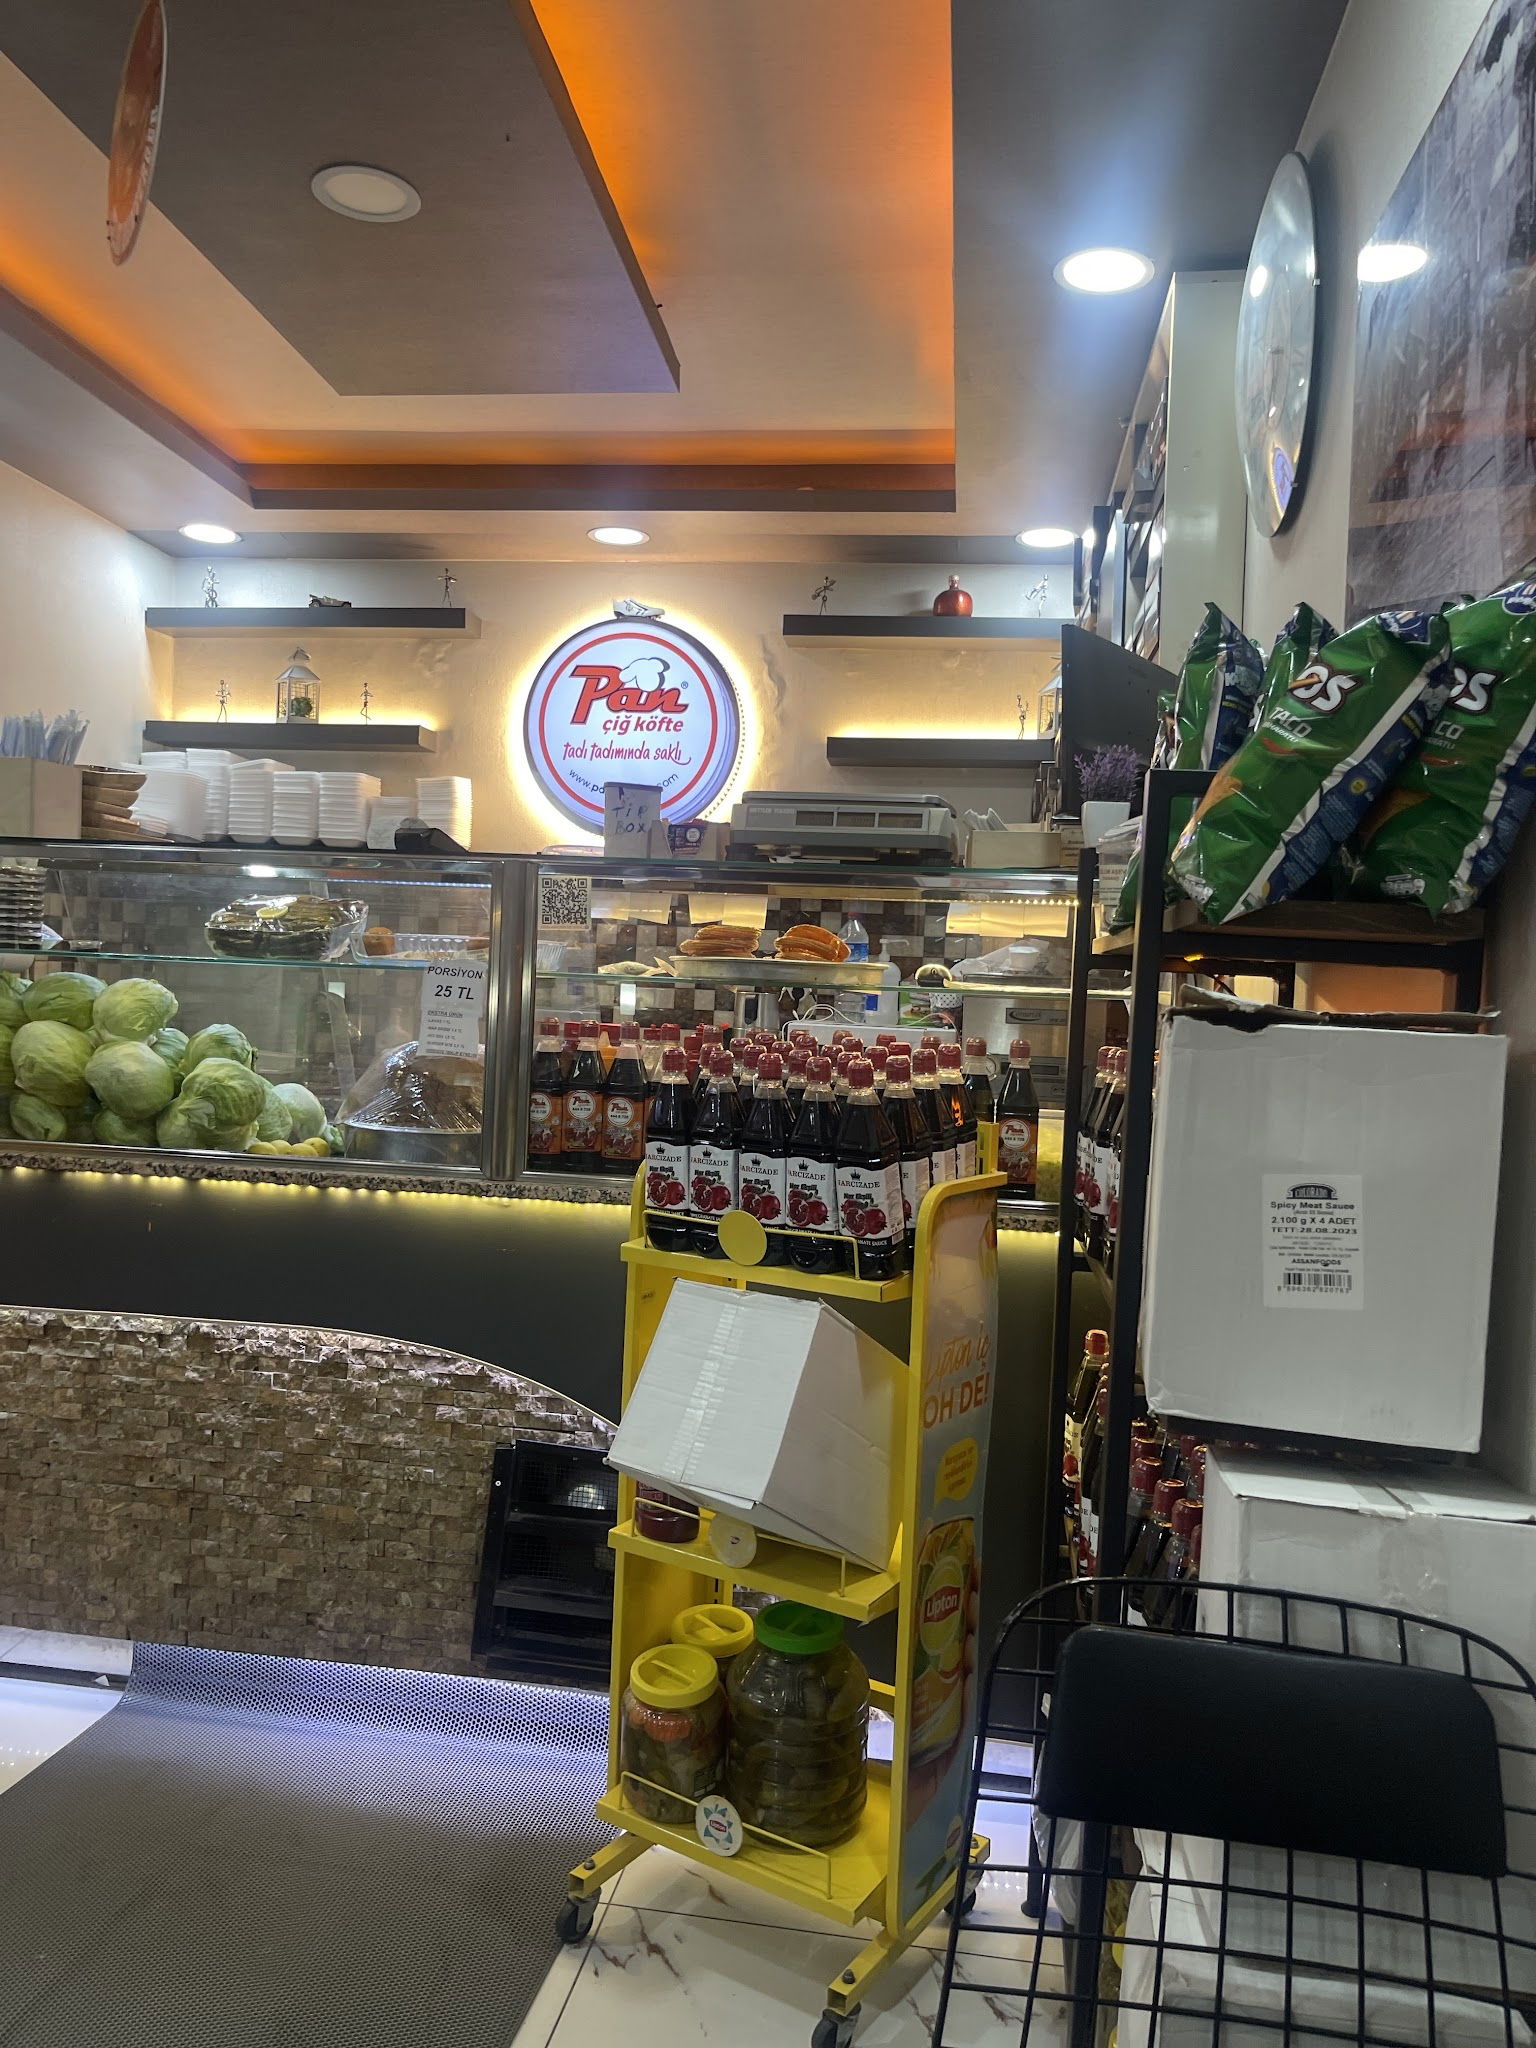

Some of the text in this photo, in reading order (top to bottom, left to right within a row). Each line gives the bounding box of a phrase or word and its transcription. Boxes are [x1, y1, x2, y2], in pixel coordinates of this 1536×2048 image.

[569, 664, 689, 725] Pan
[602, 714, 684, 735] çiğ köfte
[1269, 706, 1313, 738] TACO
[562, 739, 692, 766] tadı tadımında saklı
[427, 966, 483, 979] PORSİYON
[434, 984, 475, 1000] 25 TL
[1270, 1201, 1297, 1210] Spicy
[1328, 1217, 1356, 1225] ADET
[1291, 1258, 1342, 1267] ASSANFOODS
[923, 1372, 990, 1429] OH DE!
